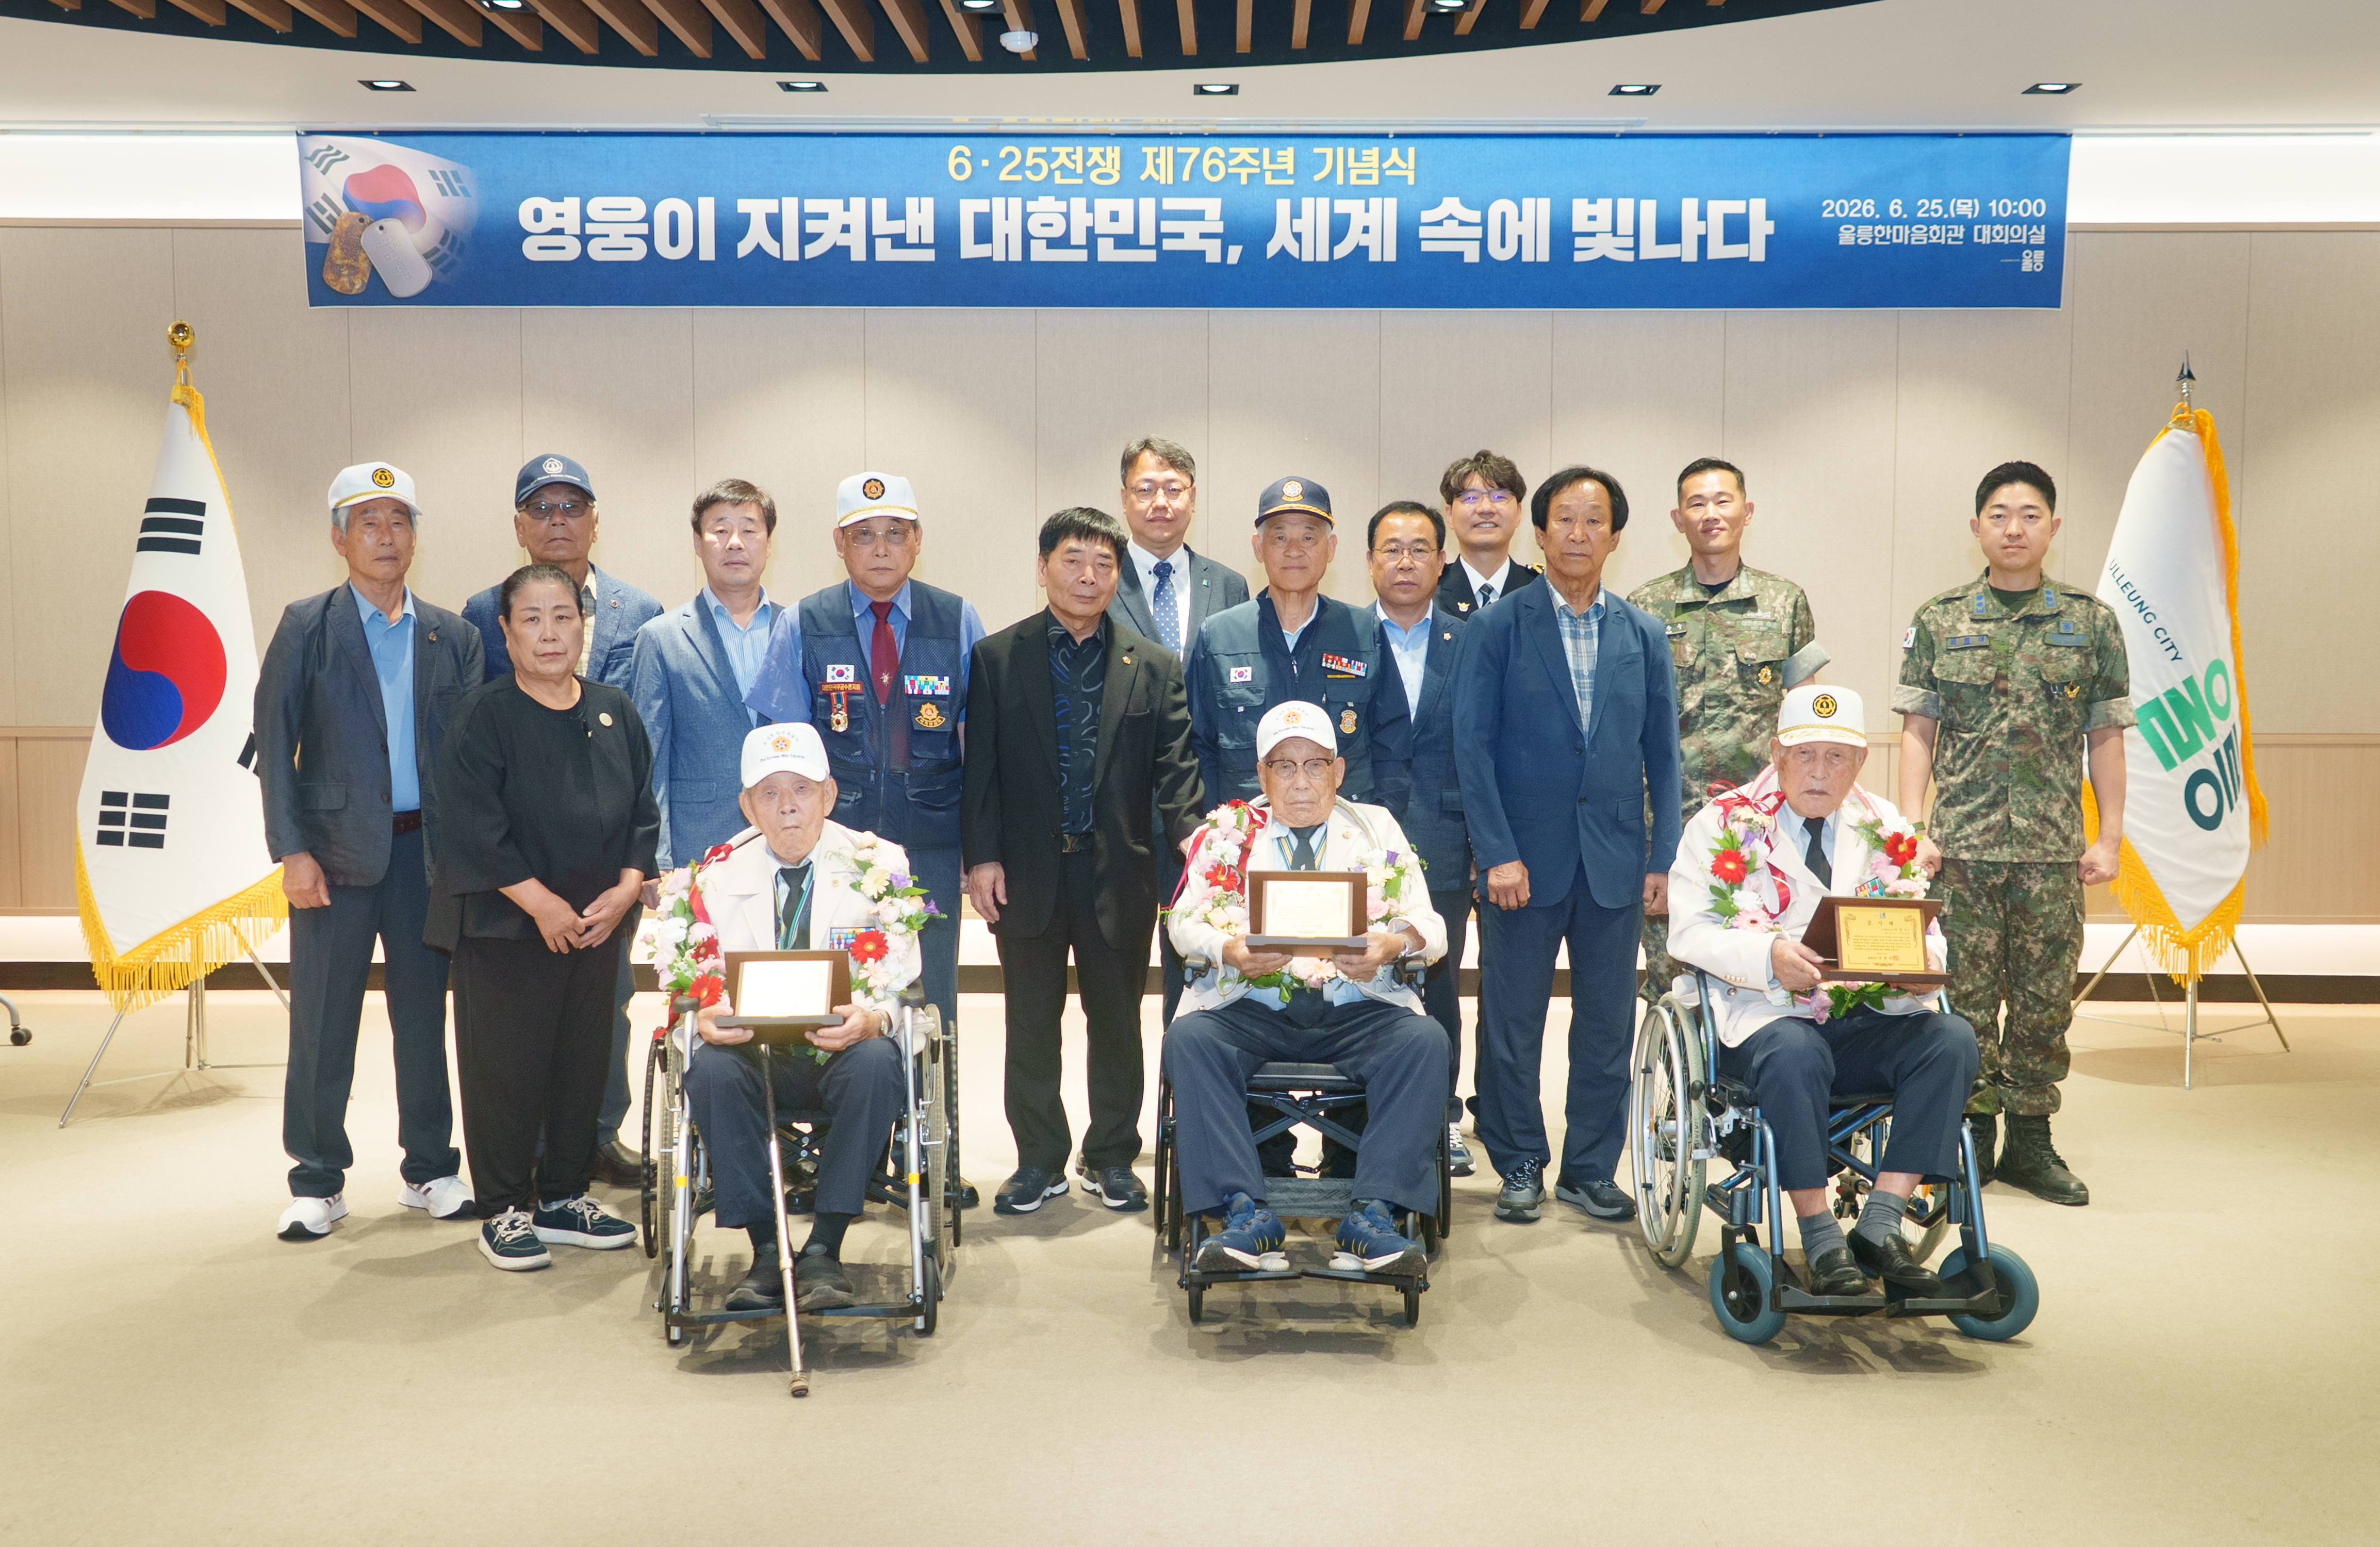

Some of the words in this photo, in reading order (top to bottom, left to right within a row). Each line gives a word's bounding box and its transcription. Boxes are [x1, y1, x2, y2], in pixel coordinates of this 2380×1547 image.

[1139, 145, 1295, 186] 제76주년
[1312, 146, 1416, 186] 기념식
[1821, 199, 1880, 219] 2026.
[1889, 199, 1908, 219] 6.
[1988, 198, 2046, 218] 10:00
[518, 196, 716, 261] 영웅이
[736, 196, 935, 261] 지켜낸
[959, 195, 1243, 265] 대한민국,
[1267, 196, 1398, 262] 세계
[1418, 196, 1551, 263] 속에
[1571, 197, 1775, 262] 빛나다
[1838, 224, 1965, 245] 울릉한마음회관
[1974, 224, 2046, 244] 대회의실
[2109, 558, 2157, 624] ULLEUNG
[2154, 627, 2183, 662] CITY
